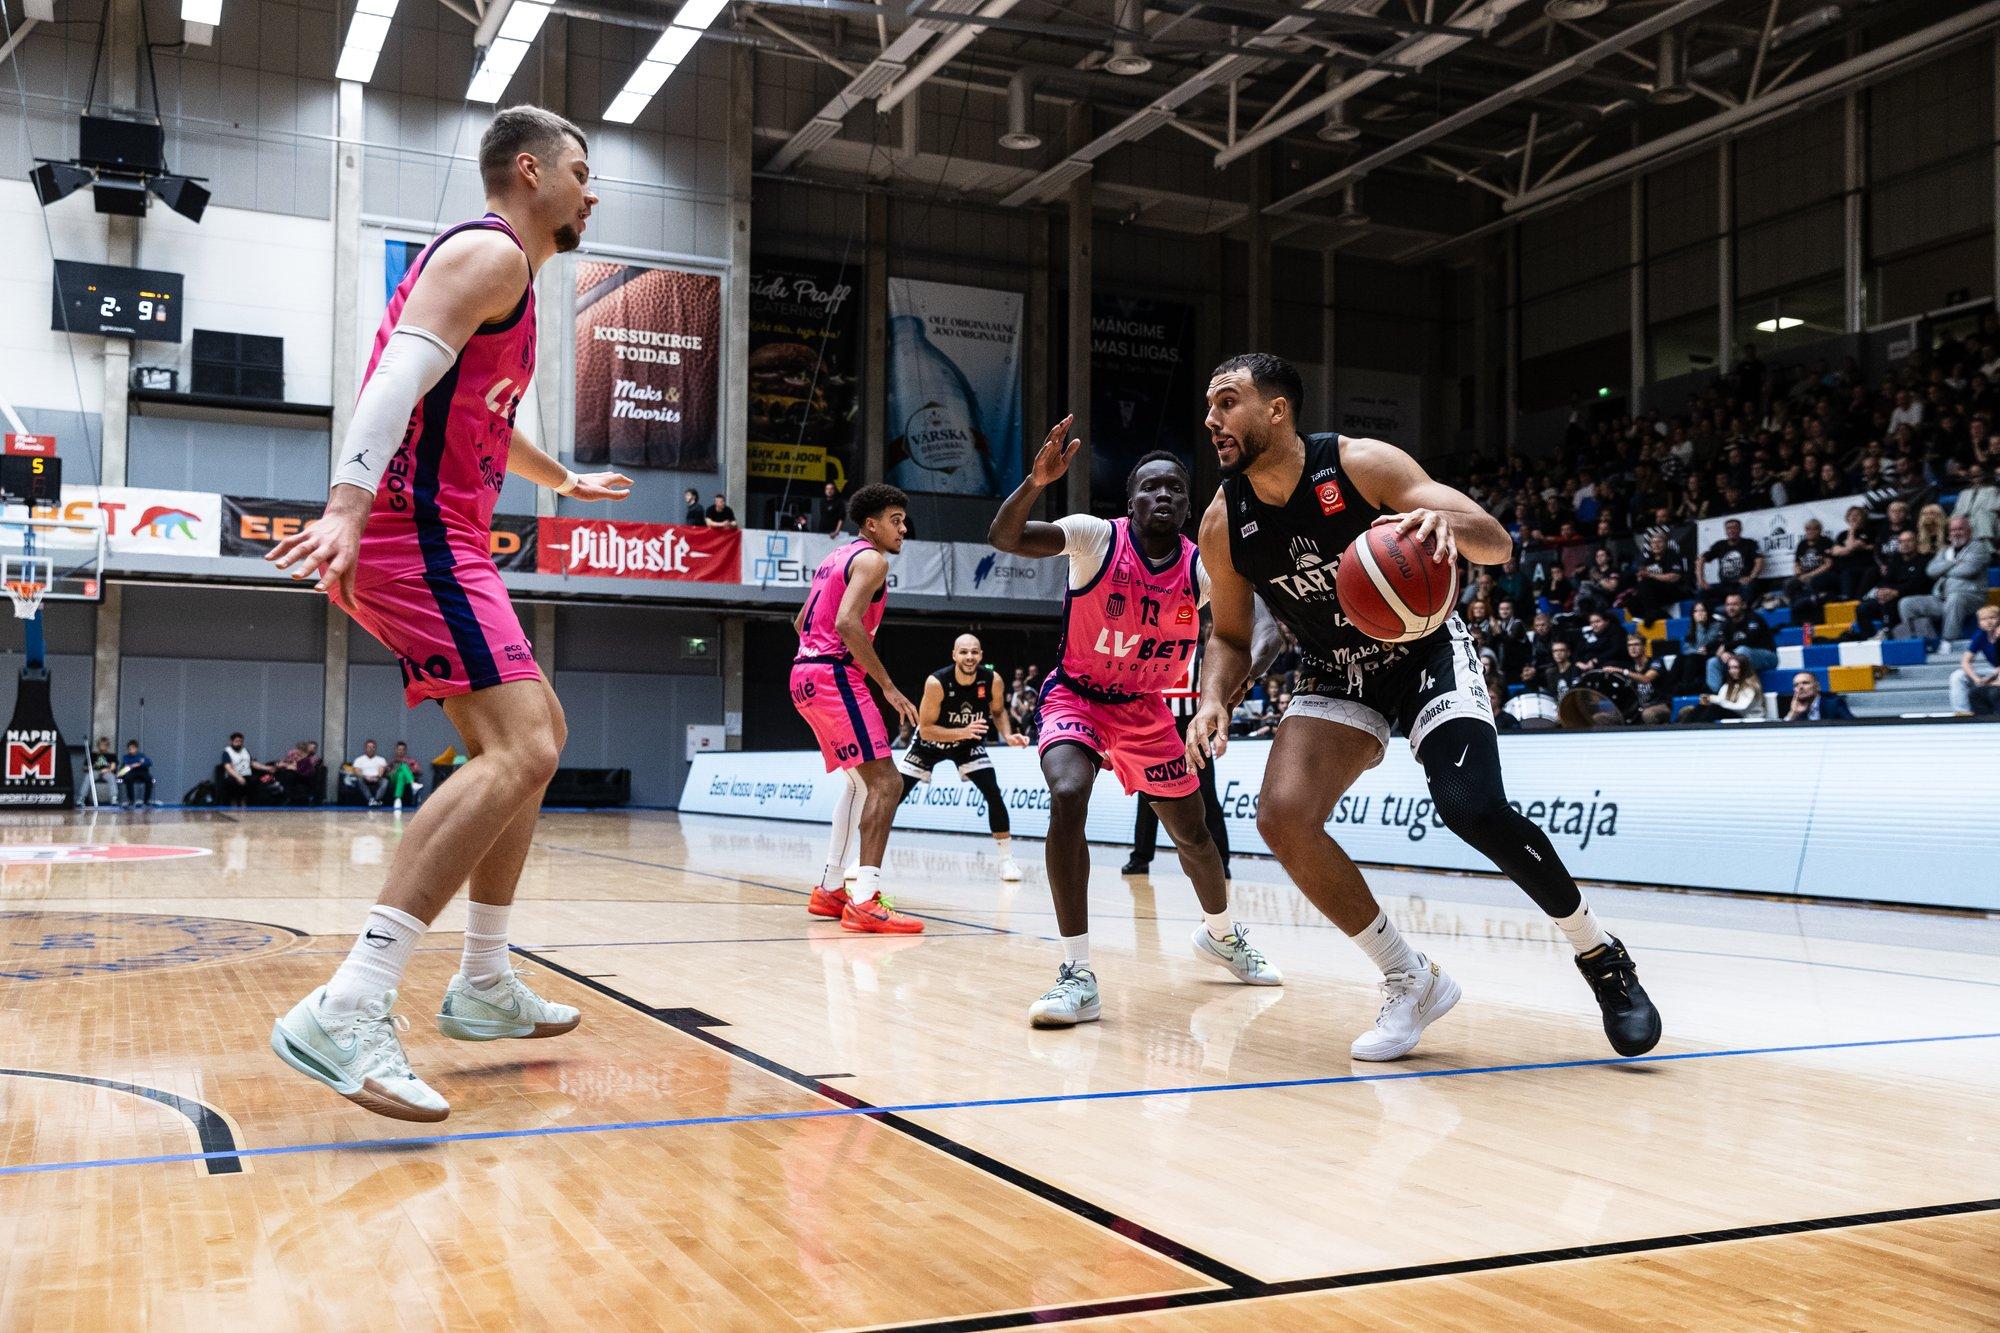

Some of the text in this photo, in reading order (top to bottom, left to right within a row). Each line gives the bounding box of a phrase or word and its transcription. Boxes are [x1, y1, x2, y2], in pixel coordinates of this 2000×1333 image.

[793, 281, 851, 314] Proff
[929, 316, 945, 325] OLE
[593, 325, 702, 350] KOSSUKIRGE
[1092, 339, 1128, 356] MAS
[615, 344, 680, 365] TOIDAB
[614, 379, 680, 402] Maks &
[612, 399, 681, 423] Moorits
[568, 523, 691, 576] Pühaste
[994, 566, 1036, 581] ESTIKO
[1269, 552, 1343, 601] TART
[1140, 596, 1161, 628] 13
[6, 729, 58, 742] MAPRI
[924, 785, 962, 808] kossu
